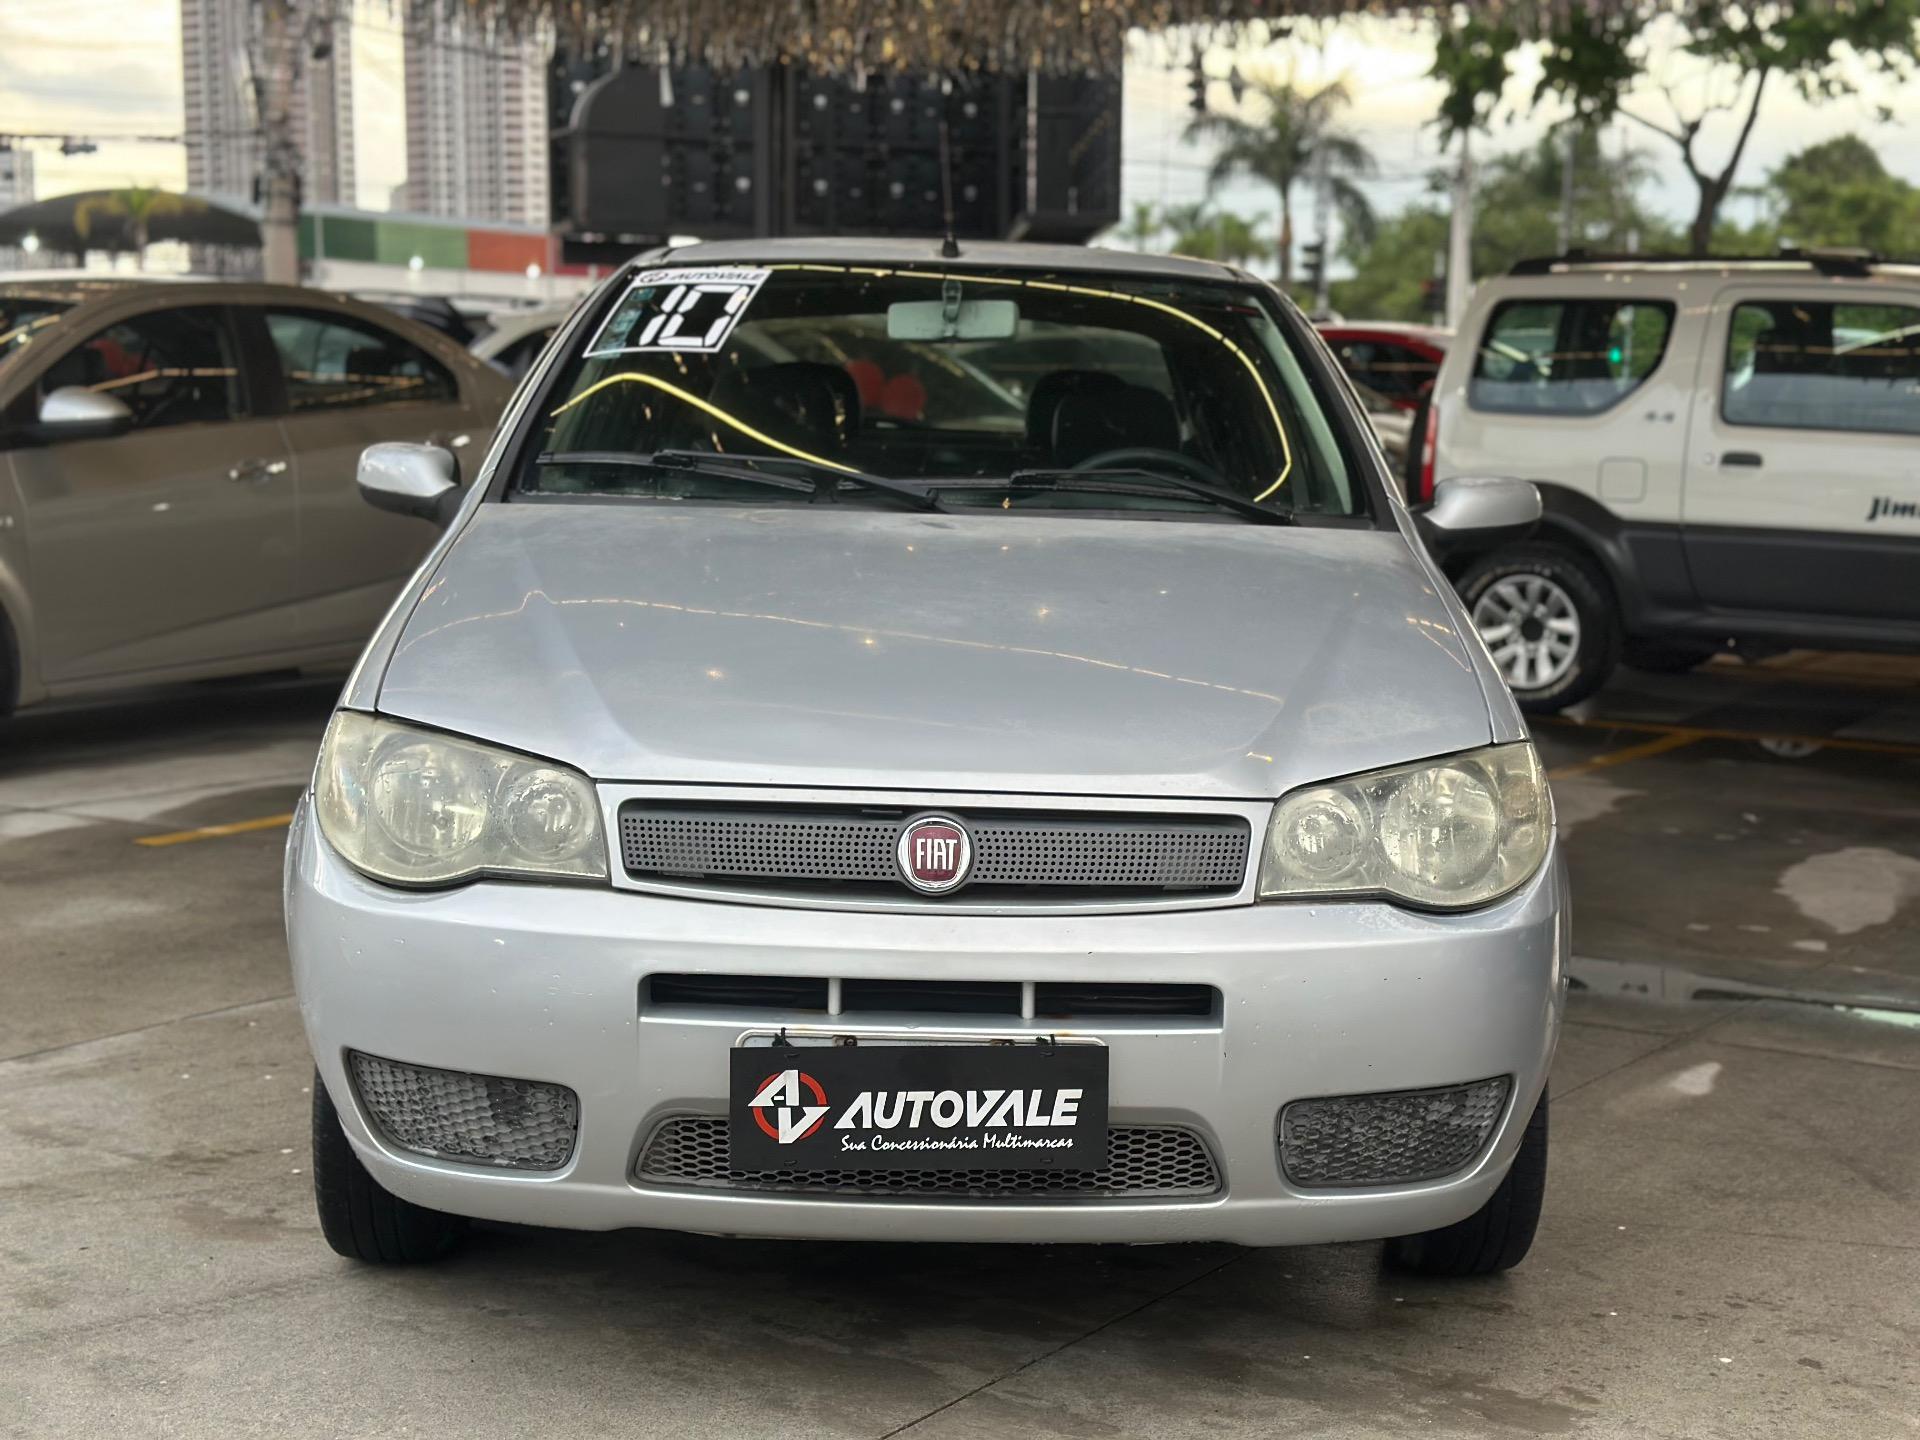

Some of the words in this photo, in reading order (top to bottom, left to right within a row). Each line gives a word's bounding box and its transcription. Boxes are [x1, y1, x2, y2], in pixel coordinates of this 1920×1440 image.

[670, 272, 765, 281] AUTOVALE
[638, 284, 750, 347] 10
[1866, 497, 1920, 522] Jim
[916, 838, 957, 870] FIAT
[833, 1088, 1083, 1129] AUTOVALE
[841, 1134, 867, 1152] Sua
[871, 1134, 978, 1151] Concessionária
[983, 1132, 1074, 1149] Multimarcas
